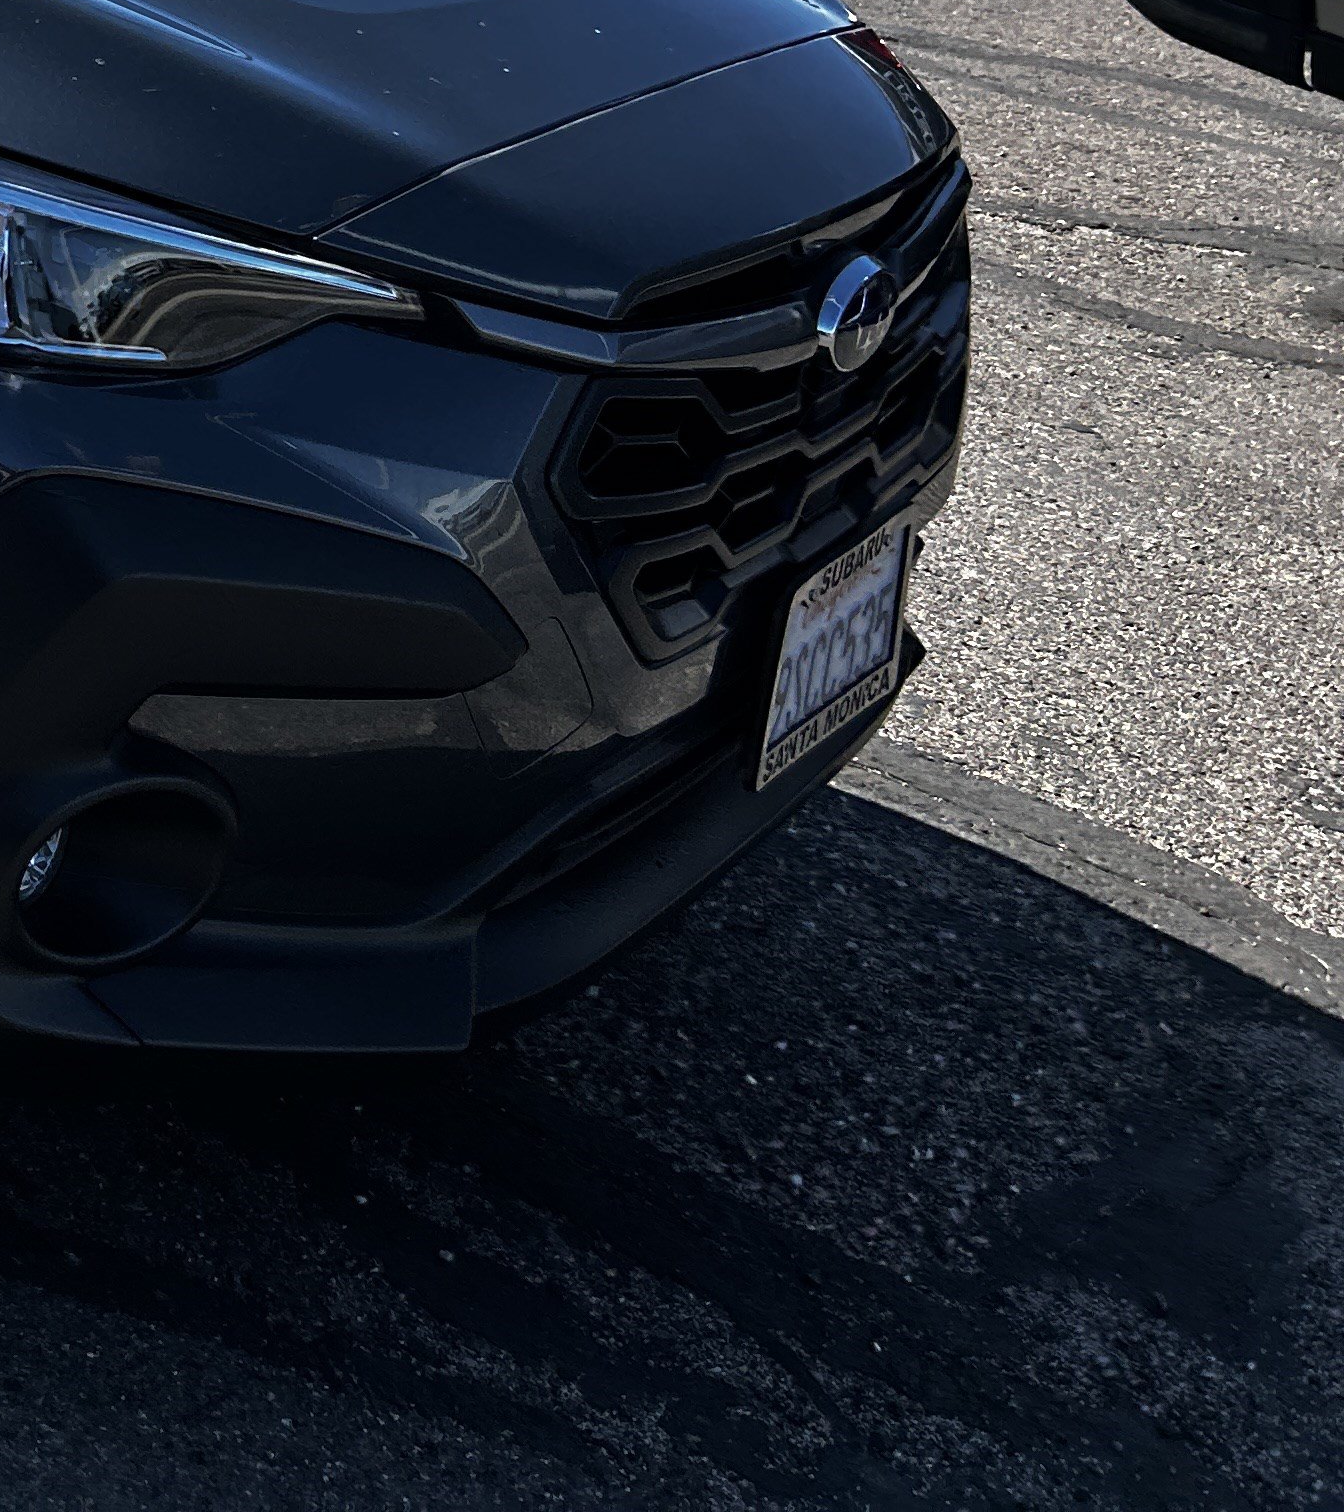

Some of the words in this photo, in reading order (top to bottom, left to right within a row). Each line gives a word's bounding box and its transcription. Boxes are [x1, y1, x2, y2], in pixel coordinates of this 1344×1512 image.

[819, 527, 886, 596] SUBARU
[763, 718, 818, 784] SANTA
[823, 667, 891, 737] MONICA
